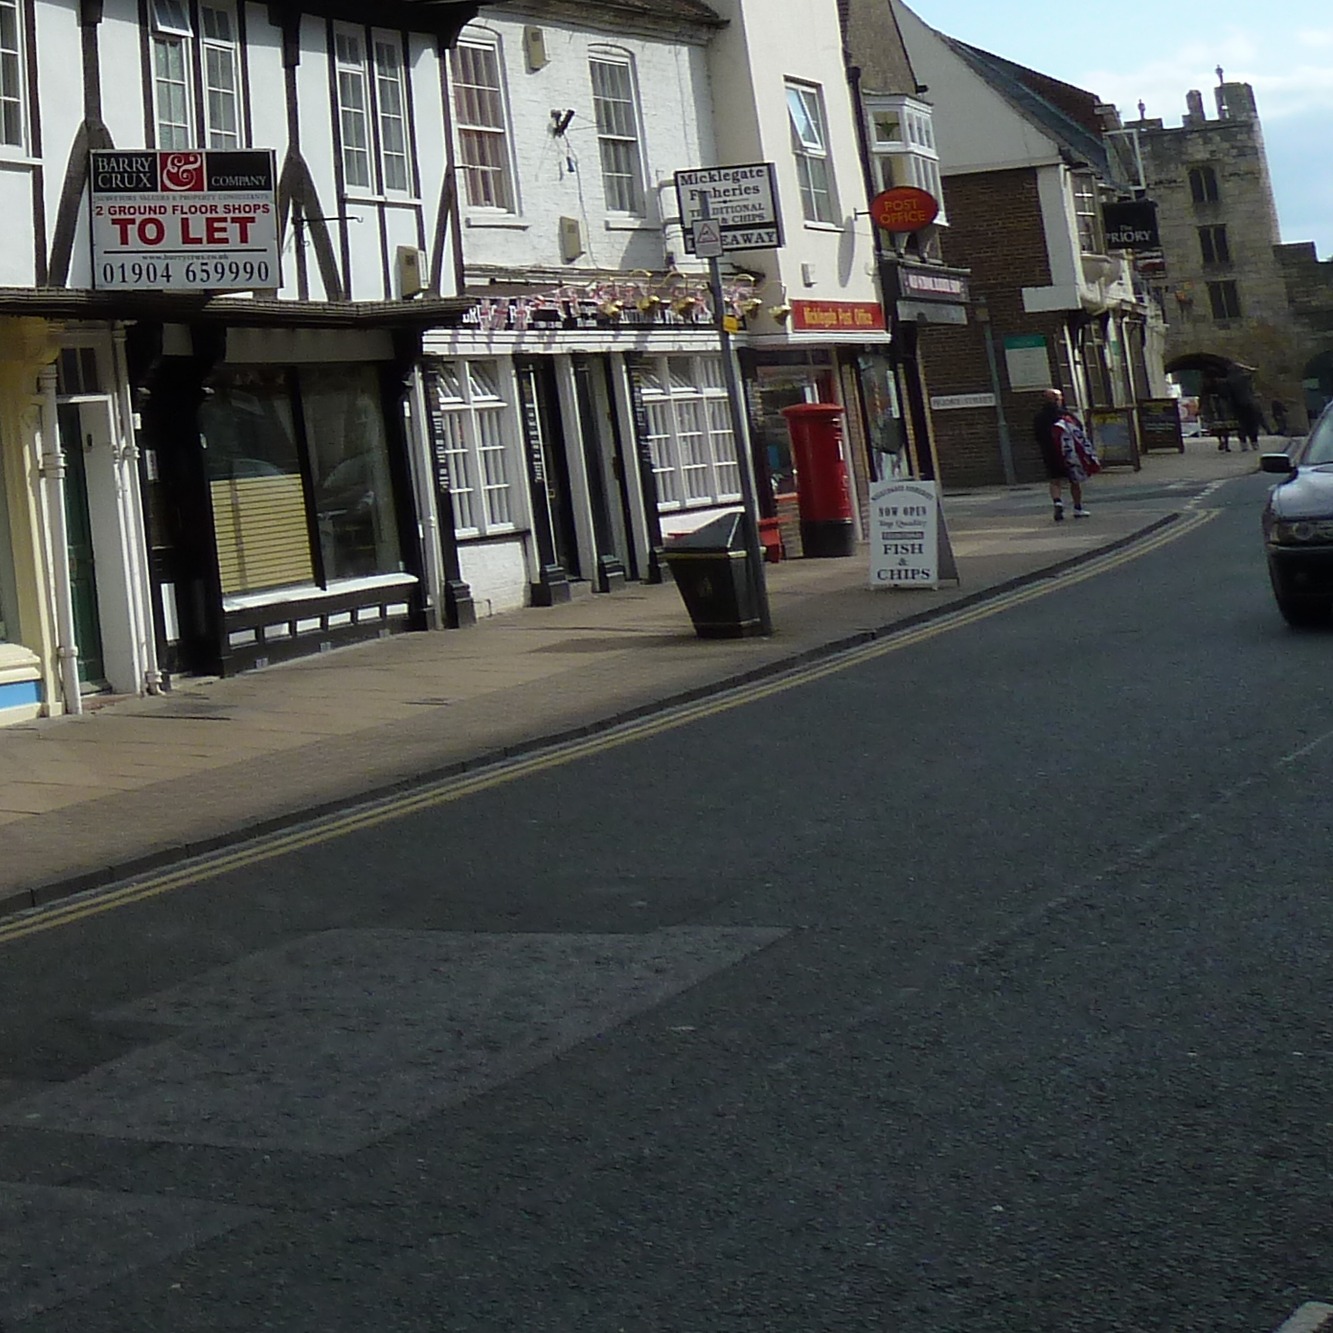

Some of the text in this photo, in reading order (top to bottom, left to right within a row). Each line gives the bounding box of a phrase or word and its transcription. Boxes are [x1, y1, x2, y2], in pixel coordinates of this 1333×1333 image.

[98, 157, 153, 173] BARRY
[98, 173, 152, 188] CRUX
[211, 175, 267, 187] COMPANY
[680, 168, 765, 186] Micklegate
[689, 185, 760, 201] Fheries
[95, 204, 271, 216] 2 GROUND FLOOR SHOPS
[884, 199, 918, 212] POST
[732, 213, 765, 224] CHIPS
[880, 211, 926, 224] OFFICE
[111, 216, 256, 246] TO LET
[688, 232, 776, 249] TEAWAY
[103, 261, 269, 284] 01904 659990
[878, 506, 927, 517] NOW OPEN
[883, 543, 924, 555] FISH
[877, 568, 931, 580] CHIPS
